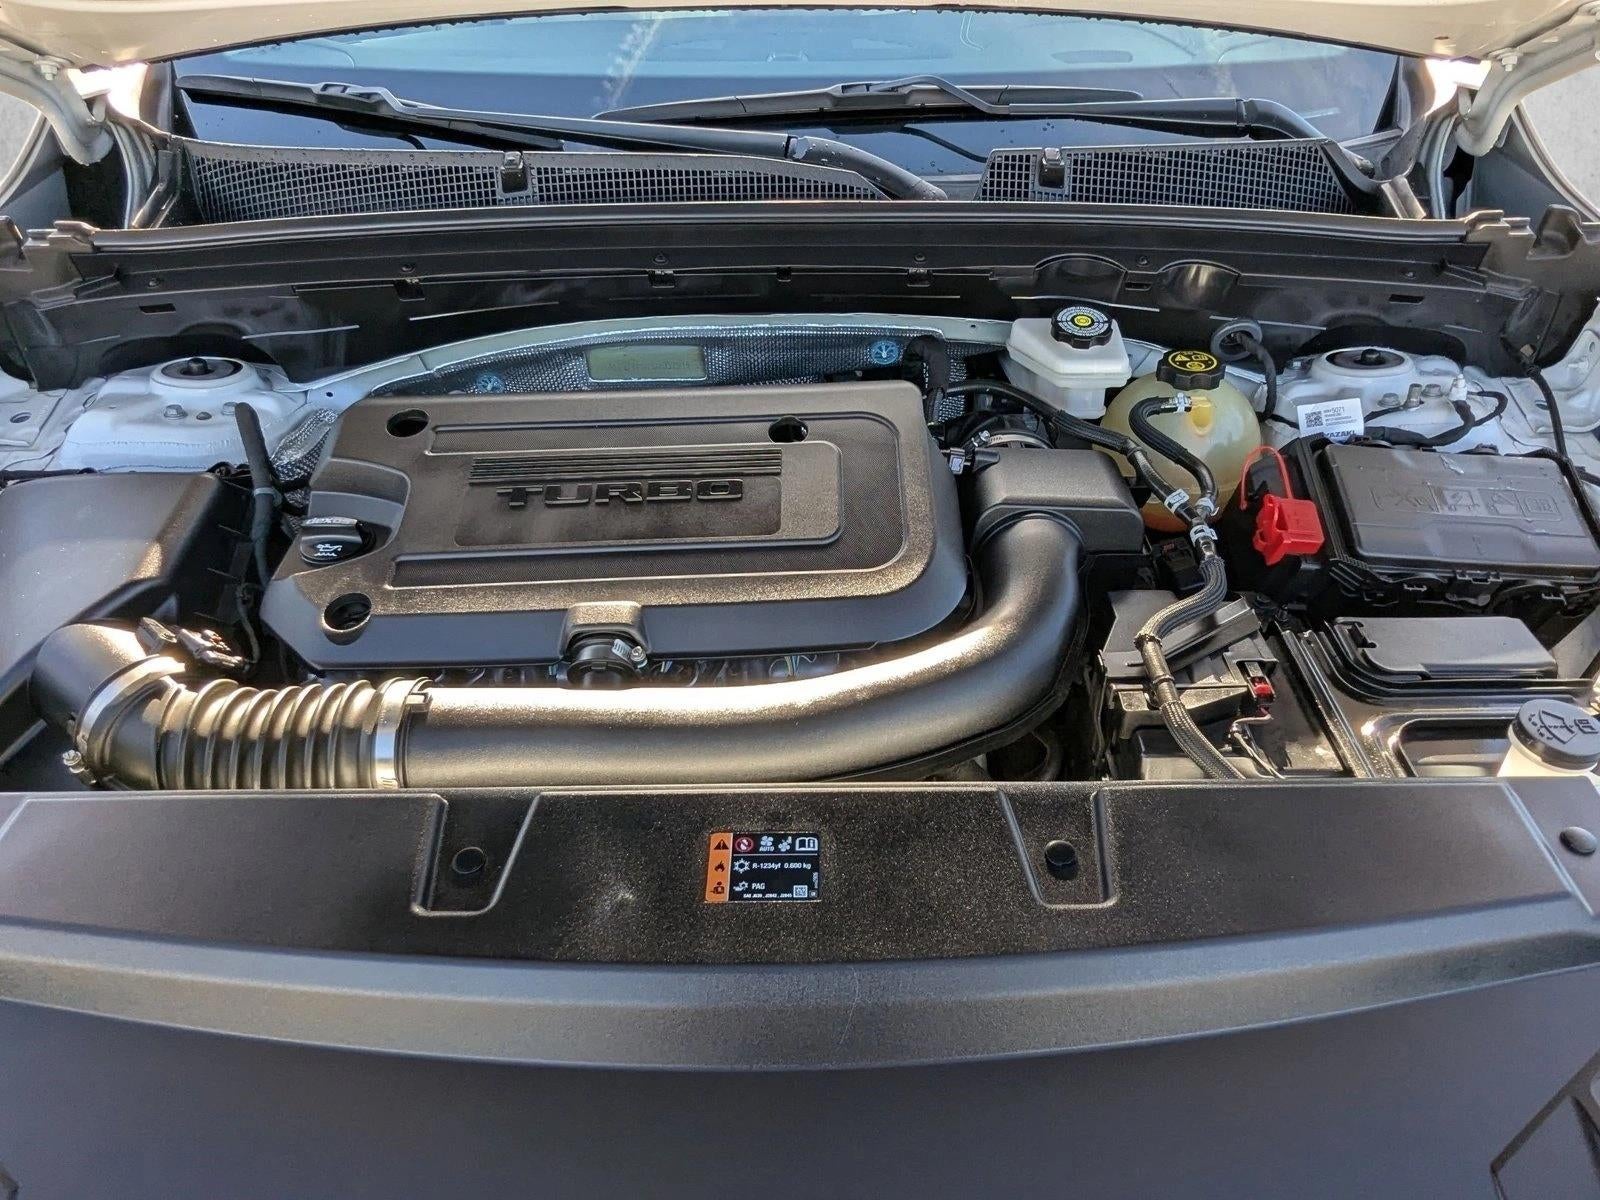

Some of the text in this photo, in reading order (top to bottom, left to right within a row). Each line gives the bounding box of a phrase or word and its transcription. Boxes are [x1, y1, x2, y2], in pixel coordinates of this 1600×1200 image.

[496, 478, 744, 507] TURBO
[803, 862, 811, 870] kg
[751, 882, 766, 890] PAG
